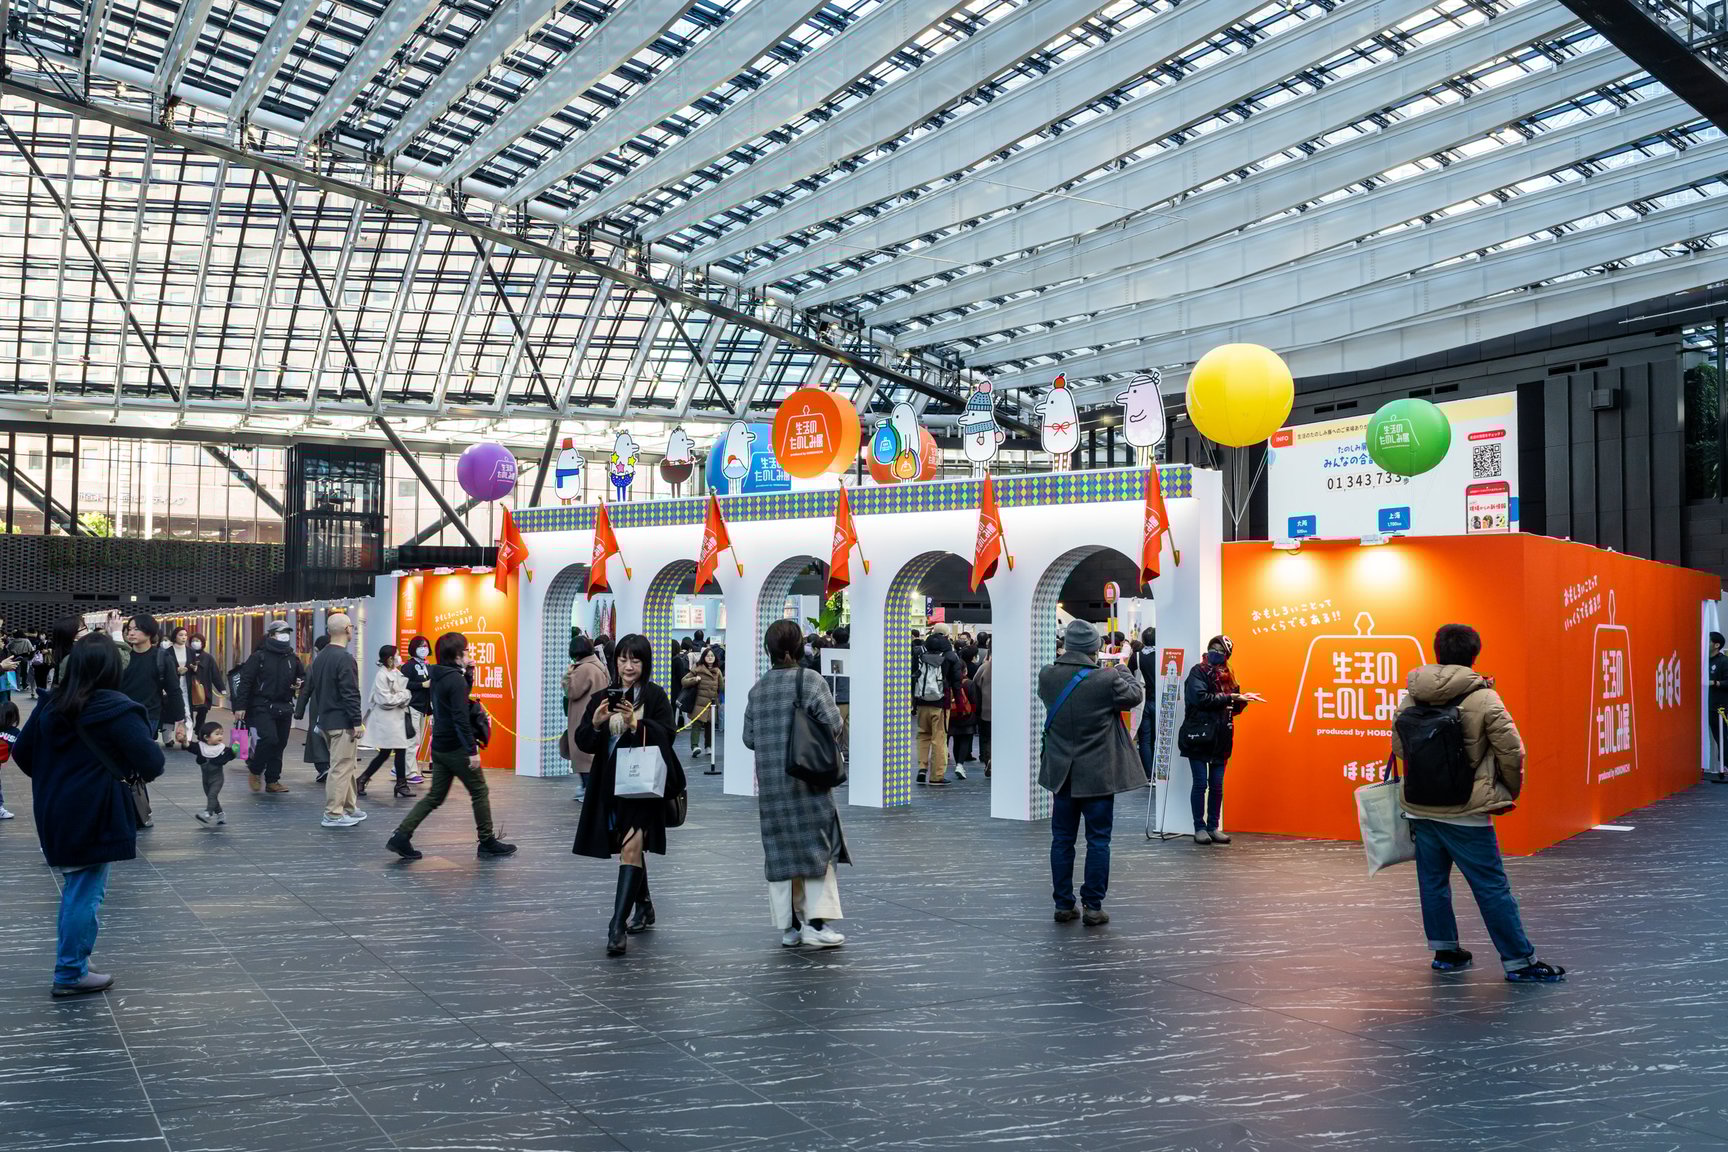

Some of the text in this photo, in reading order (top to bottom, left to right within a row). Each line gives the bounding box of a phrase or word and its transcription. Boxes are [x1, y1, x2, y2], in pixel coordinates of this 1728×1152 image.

[795, 420, 817, 436] 生活の
[1384, 423, 1403, 435] 生活の
[789, 433, 824, 450] たのしみ展
[1251, 599, 1332, 622] おもしろいことって
[468, 642, 495, 664] 生活の
[472, 666, 503, 688] のしみ展
[1332, 651, 1398, 685] 生活の
[1602, 650, 1624, 699] 生活の
[1655, 649, 1681, 711] ほぼ日
[1316, 728, 1393, 737] produced by HOBO
[1596, 703, 1631, 757] たのしみ展
